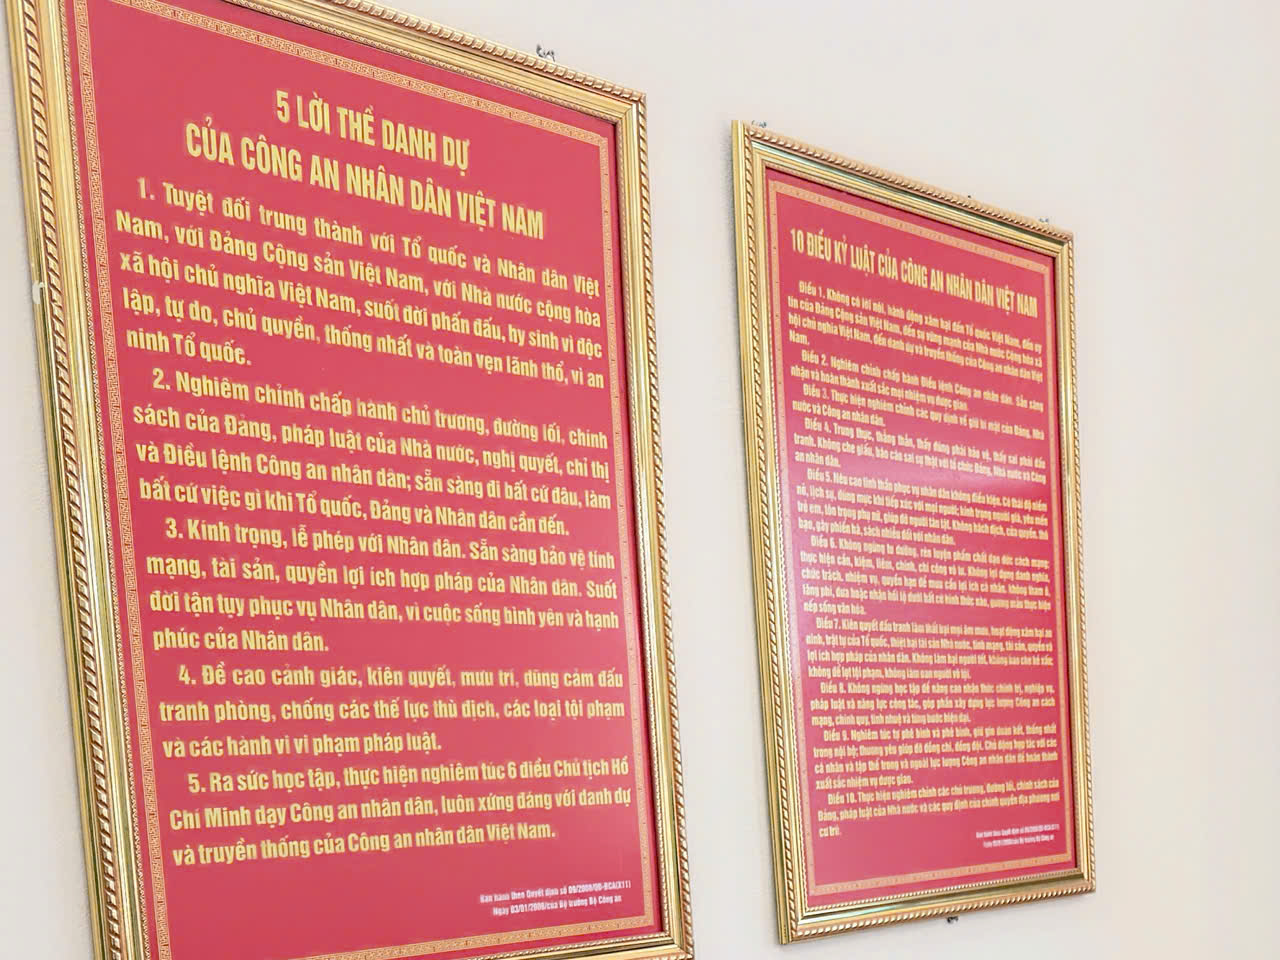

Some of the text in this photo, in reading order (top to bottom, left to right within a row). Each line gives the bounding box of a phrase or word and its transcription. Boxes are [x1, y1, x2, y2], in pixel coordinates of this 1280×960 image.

[276, 90, 470, 170] 5 LỜI THỀ DANH DỰ
[186, 116, 544, 240] CỦA CÔNG AN NHÂN DÂN VIỆT NAM
[162, 182, 214, 216] Tuyệt
[222, 196, 251, 221] đối
[259, 204, 307, 236] trung
[313, 217, 363, 246] thành
[370, 232, 395, 253] với
[401, 235, 422, 259] Tổ
[428, 245, 467, 269] quốc
[473, 254, 491, 274] và
[497, 258, 535, 283] Nhân
[542, 268, 568, 290] dân
[573, 275, 600, 300] Việt
[174, 225, 204, 248] với
[209, 229, 257, 262] Đảng
[262, 241, 308, 272] Cộng
[313, 251, 345, 277] sản
[349, 259, 382, 287] Việt
[433, 279, 456, 299] với
[461, 282, 492, 306] Nhà
[496, 293, 532, 314] nước
[536, 300, 571, 324] cộng
[575, 305, 601, 328] hòa
[790, 228, 804, 254] 10
[850, 244, 876, 277] LUẬT
[877, 248, 899, 281] CỦA
[900, 257, 928, 289] CÔNG
[929, 268, 944, 293] AN
[945, 272, 973, 301] NHÂN
[974, 278, 994, 307] DÂN
[995, 285, 1015, 315] VIỆT
[1016, 293, 1038, 318] NAM
[120, 250, 145, 274] xã
[148, 254, 180, 283] hội
[184, 263, 219, 288] chủ
[223, 272, 275, 299] nghĩa
[278, 280, 313, 308] Việt
[364, 299, 400, 322] suốt
[402, 305, 428, 327] đời
[431, 311, 470, 335] phấn
[508, 324, 525, 347] hy
[528, 329, 559, 351] sinh
[561, 335, 574, 353] vì
[576, 337, 602, 360] độc
[126, 328, 170, 353] ninh
[172, 331, 196, 357] Tổ
[164, 295, 185, 323] tự
[222, 307, 257, 331] chủ
[324, 324, 372, 353] thống
[376, 334, 413, 358] nhất
[416, 342, 435, 361] và
[437, 344, 473, 367] toàn
[475, 353, 503, 375] vẹn
[506, 355, 538, 378] lãnh
[571, 367, 584, 385] vì
[587, 372, 604, 389] an
[135, 440, 160, 463] và
[163, 442, 207, 468] Điều
[211, 448, 252, 475] lệnh
[256, 453, 302, 480] Công
[306, 463, 327, 480] an
[331, 463, 373, 485] nhân
[414, 468, 443, 492] sẵn
[446, 475, 484, 499] sàng
[486, 480, 501, 498] đi
[504, 480, 528, 501] bất
[531, 485, 549, 503] cứ
[584, 490, 611, 509] làm
[139, 475, 172, 502] bất
[174, 482, 198, 504] cứ
[201, 484, 241, 511] việc
[244, 489, 262, 511] gì
[264, 490, 293, 512] khi
[295, 490, 317, 514] Tổ
[369, 498, 412, 525] Đảng
[414, 504, 433, 524] và
[435, 506, 476, 528] Nhân
[478, 510, 507, 530] dân
[509, 511, 536, 533] cần
[162, 737, 186, 758] và
[189, 736, 224, 757] các
[226, 735, 272, 756] hành
[274, 735, 290, 755] vi
[293, 734, 309, 754] vi
[312, 734, 360, 757] phạm
[363, 732, 404, 755] pháp
[172, 844, 196, 866] và
[198, 837, 257, 864] truyền
[260, 835, 311, 859] thống
[313, 832, 346, 855] của
[347, 832, 390, 852] Công
[393, 833, 412, 848] an
[415, 827, 454, 847] nhân
[456, 825, 485, 844] dân
[486, 823, 515, 841] Việt
